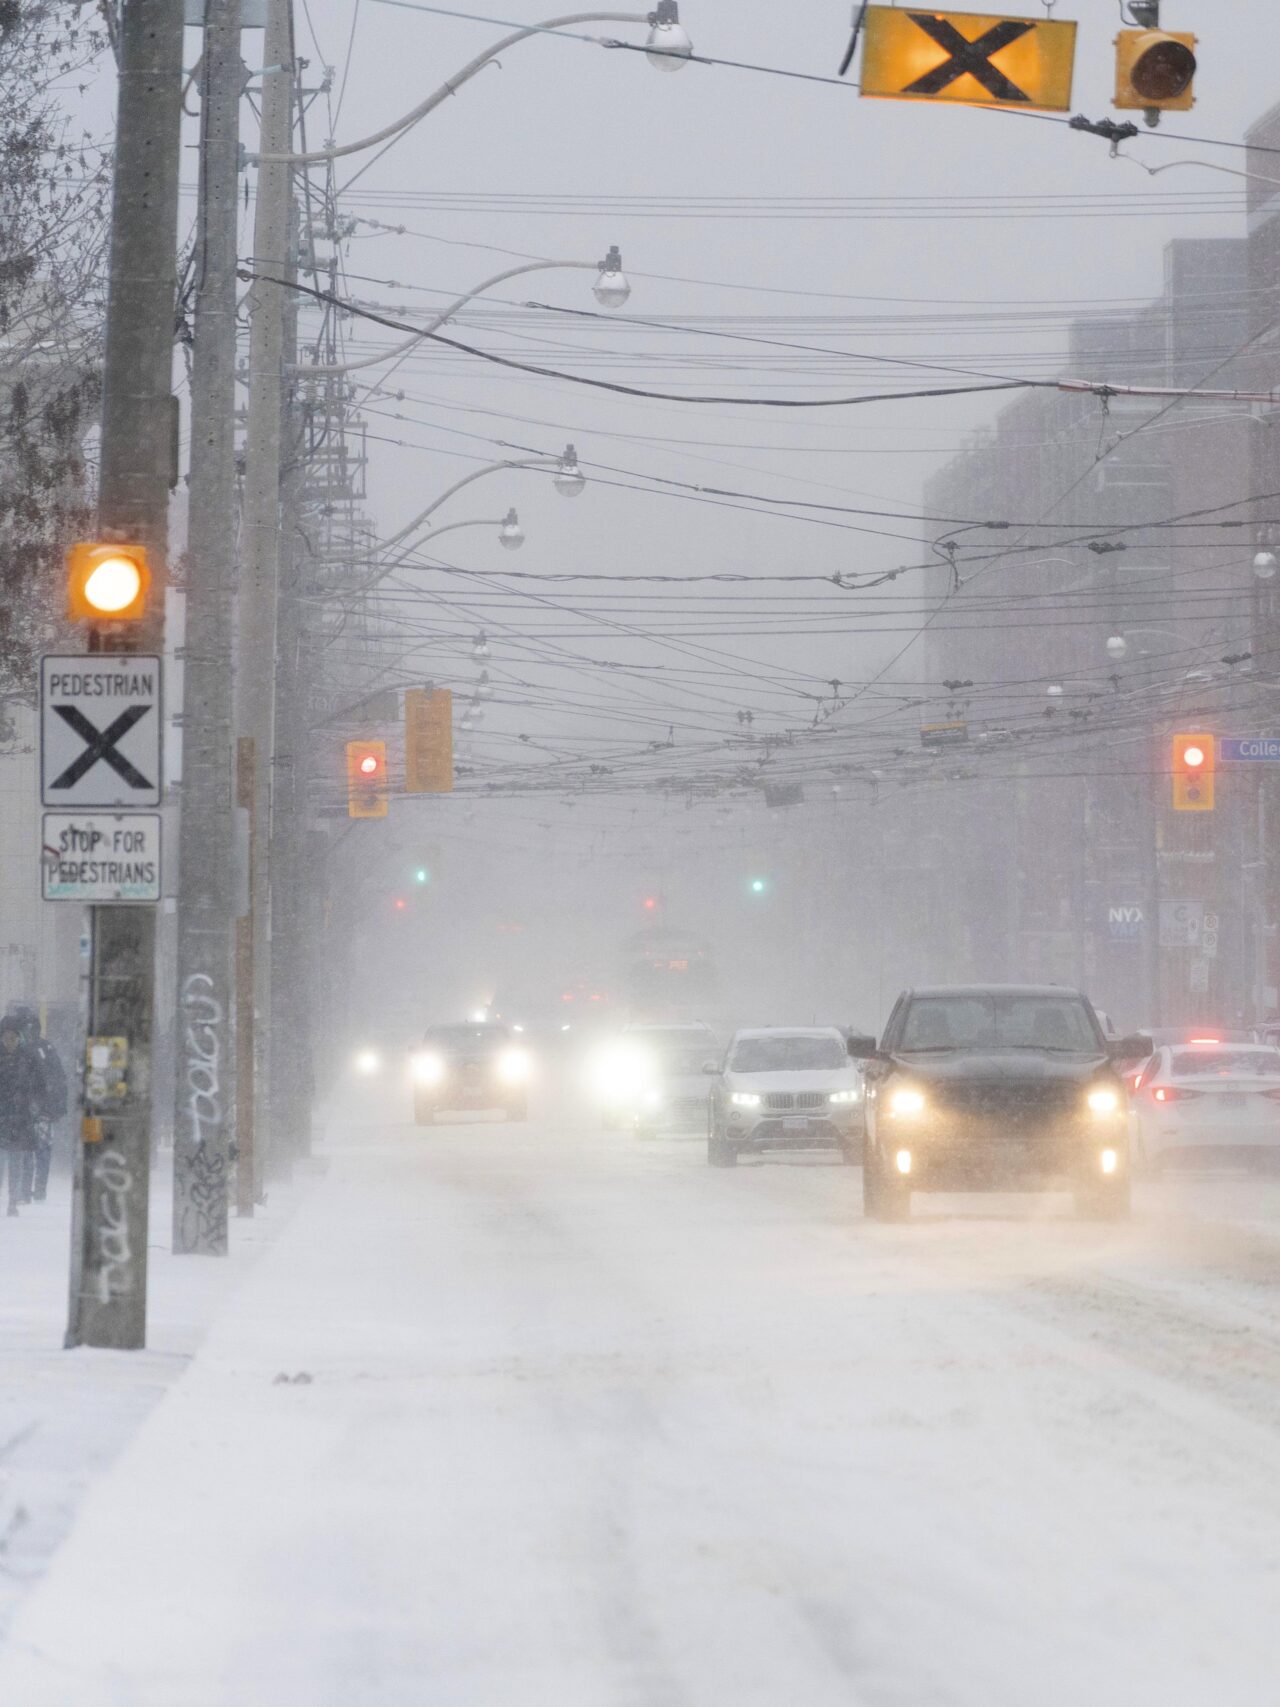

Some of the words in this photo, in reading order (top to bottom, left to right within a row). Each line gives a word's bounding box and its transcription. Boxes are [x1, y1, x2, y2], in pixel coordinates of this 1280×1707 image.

[50, 673, 153, 696] PEDESTRIAN
[60, 830, 100, 852] STOP
[113, 831, 145, 852] FOR
[49, 862, 156, 883] PEDESTRIANS
